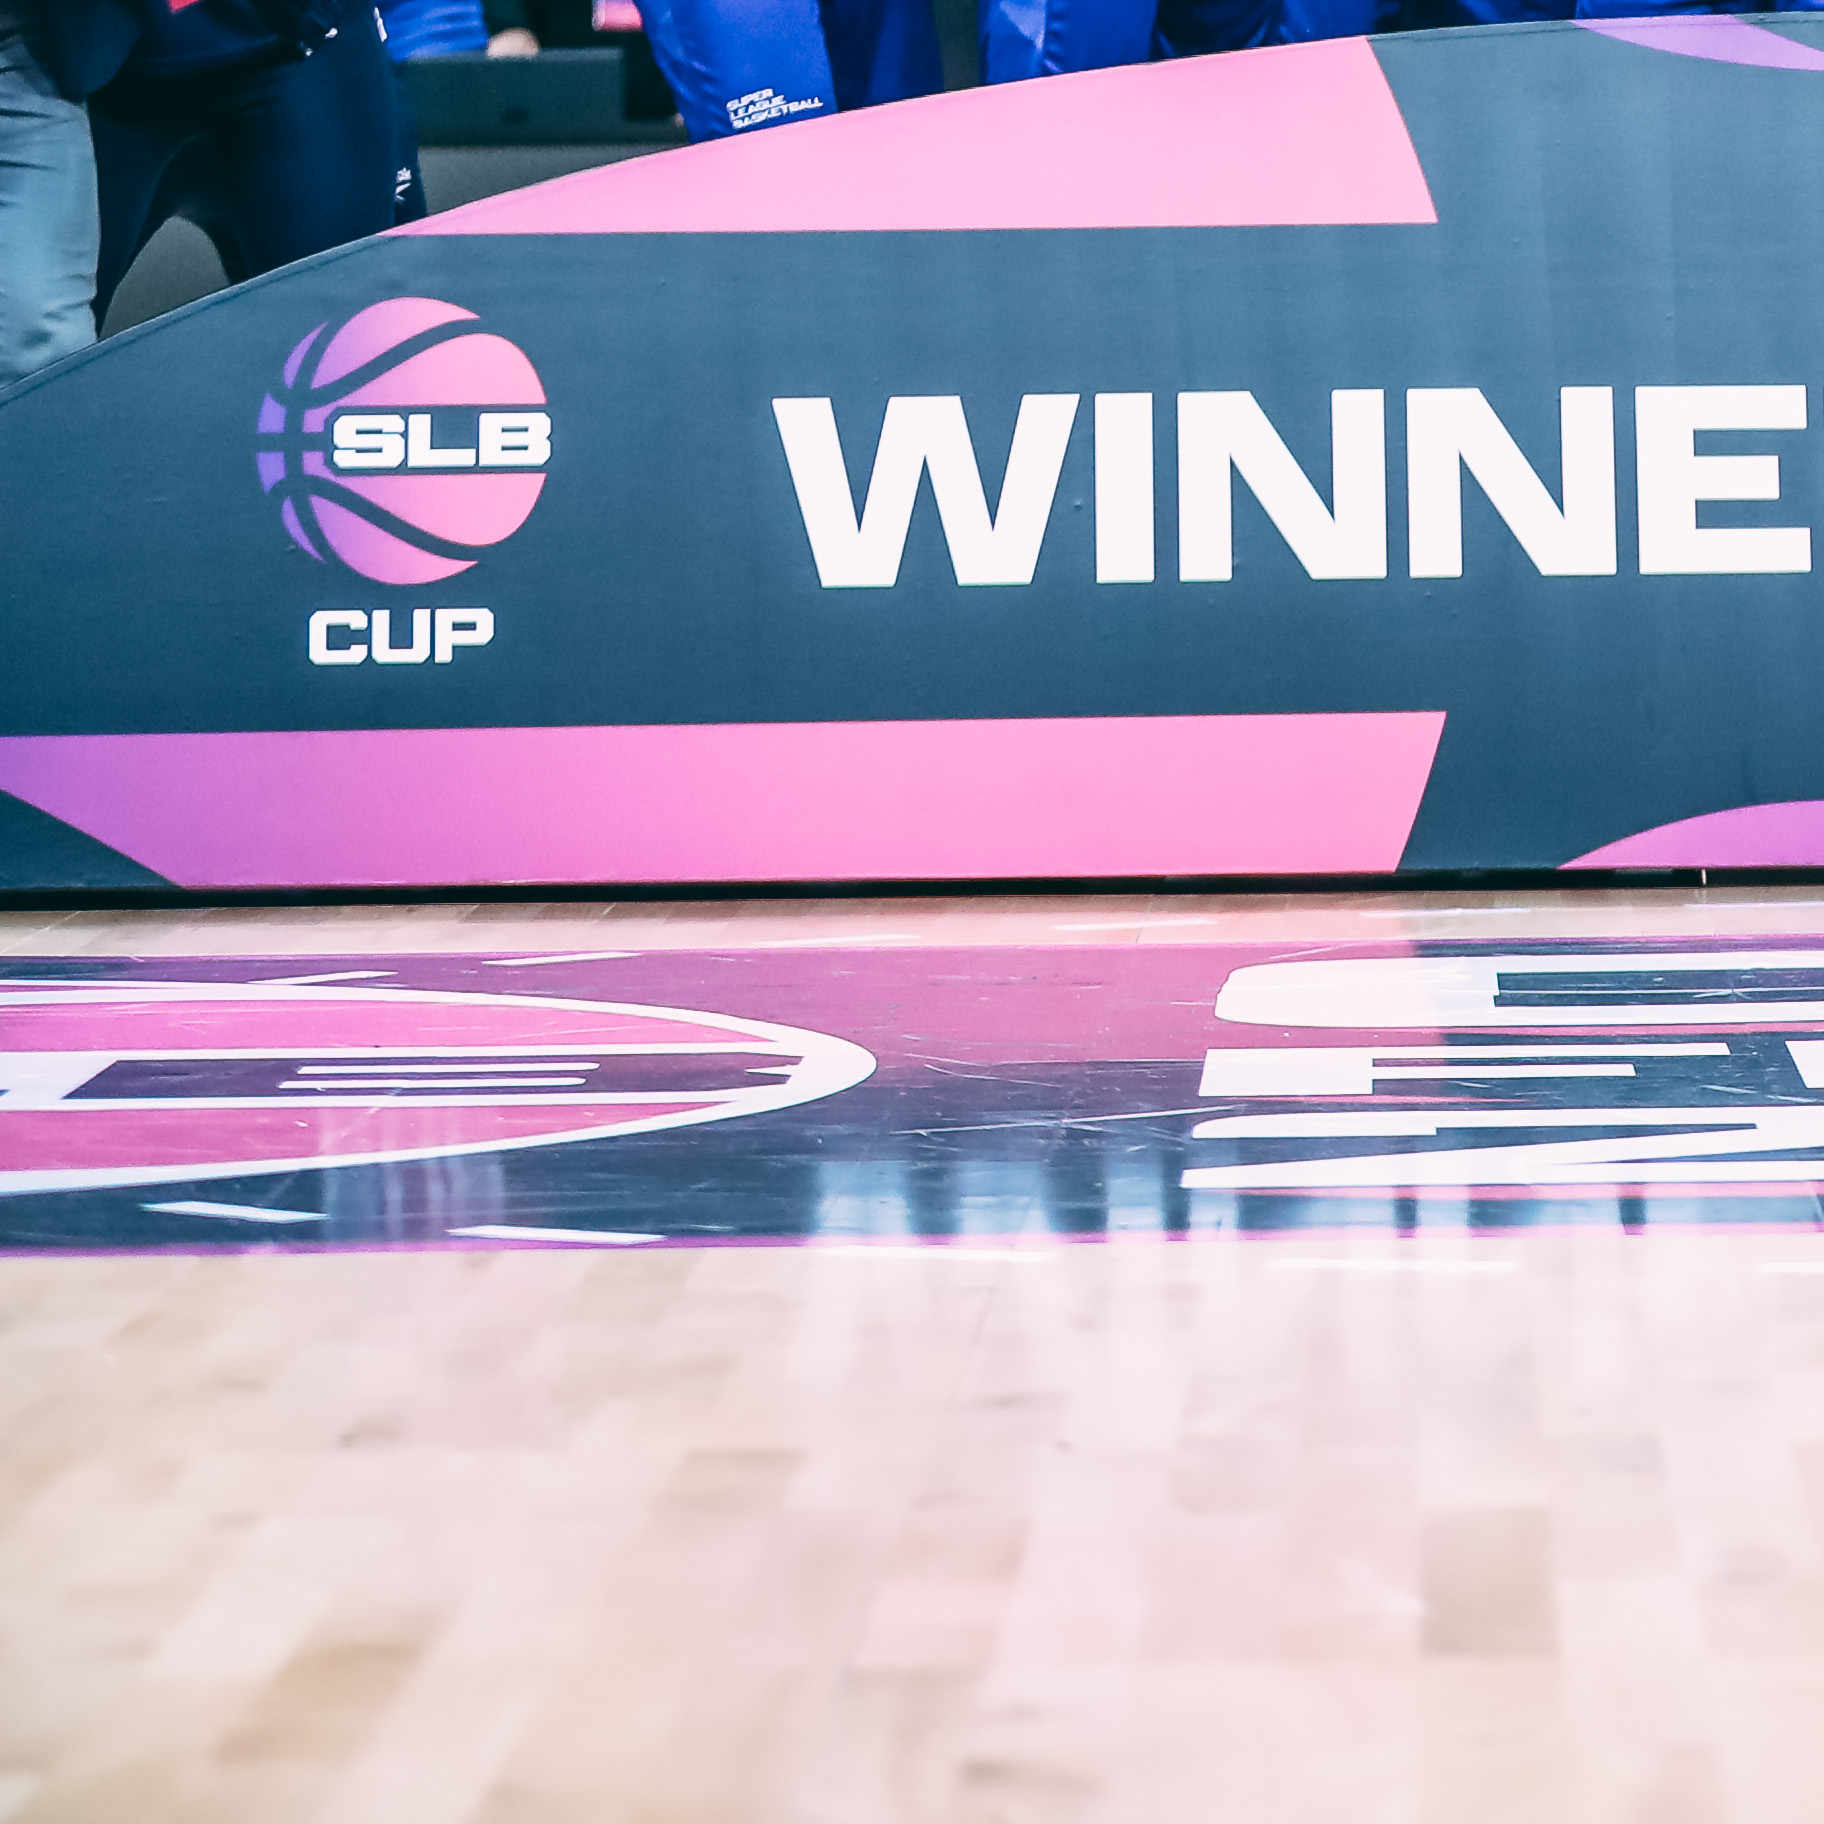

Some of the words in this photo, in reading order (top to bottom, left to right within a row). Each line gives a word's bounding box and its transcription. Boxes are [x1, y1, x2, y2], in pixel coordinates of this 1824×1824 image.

[729, 95, 787, 121] LEAGUE
[732, 96, 823, 129] BASKETBALL
[331, 412, 553, 470] SLB
[307, 607, 496, 666] CUP
